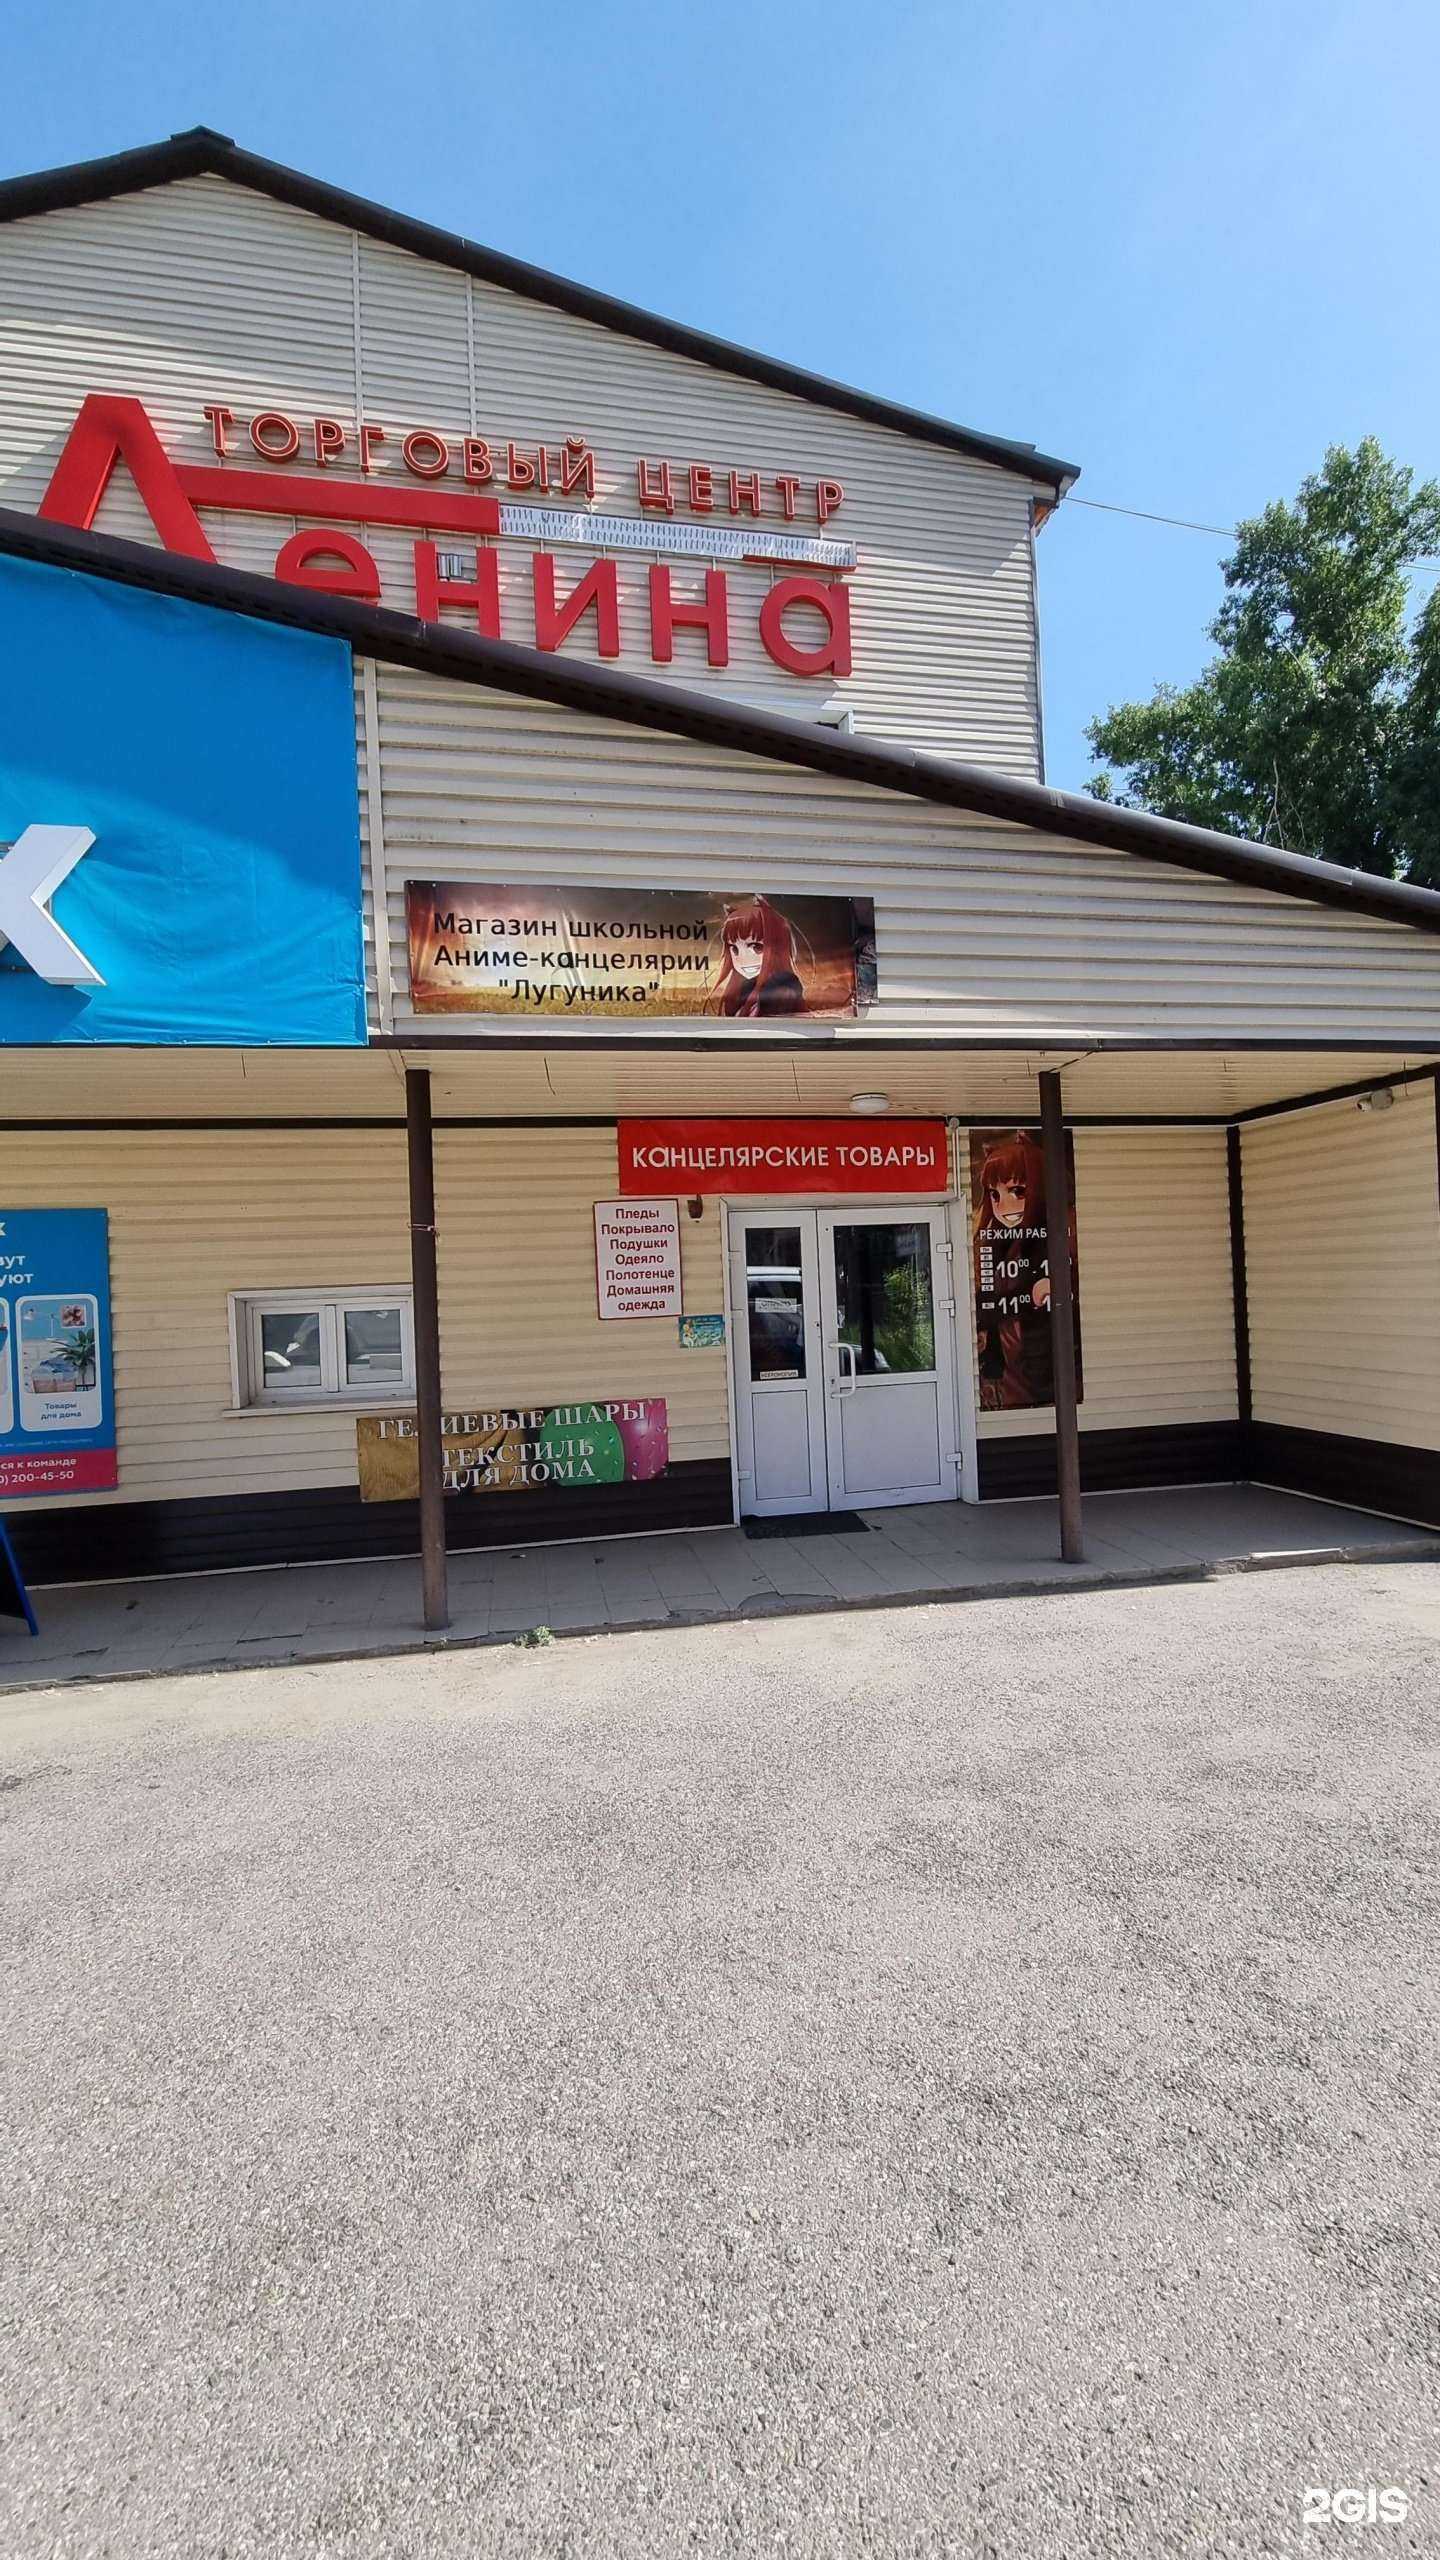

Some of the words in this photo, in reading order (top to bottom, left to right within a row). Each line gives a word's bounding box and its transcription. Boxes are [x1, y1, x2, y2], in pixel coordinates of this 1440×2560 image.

[204, 405, 596, 497] ТОРГОВЫЙ
[637, 457, 845, 523] ЦЕНТР
[434, 912, 557, 936] Магазин
[569, 920, 707, 940] школьной
[434, 945, 709, 975] Аниме-канцелярии
[499, 979, 659, 1006] "Лугуника"
[836, 1146, 935, 1166] ТОВАРЫ
[616, 1208, 660, 1220] Пледы
[601, 1224, 675, 1236] Покрывало
[979, 1228, 1023, 1240] РЕЖИМ
[610, 1239, 668, 1251] Подушки
[615, 1254, 664, 1266] Одеяло
[606, 1269, 675, 1280] Полотенце
[606, 1285, 675, 1299] Домашняя
[618, 1300, 666, 1311] одежда
[378, 1410, 544, 1439] ГЕИЕВЫЕ
[554, 1402, 646, 1426] ШАРЫ
[443, 1439, 594, 1467] ТЕКСТИЛЬ
[27, 1459, 77, 1467] команде
[12, 1471, 74, 1483] 200-45-50
[442, 1467, 500, 1489] ДЛЯ
[510, 1459, 595, 1487] ДОМА
